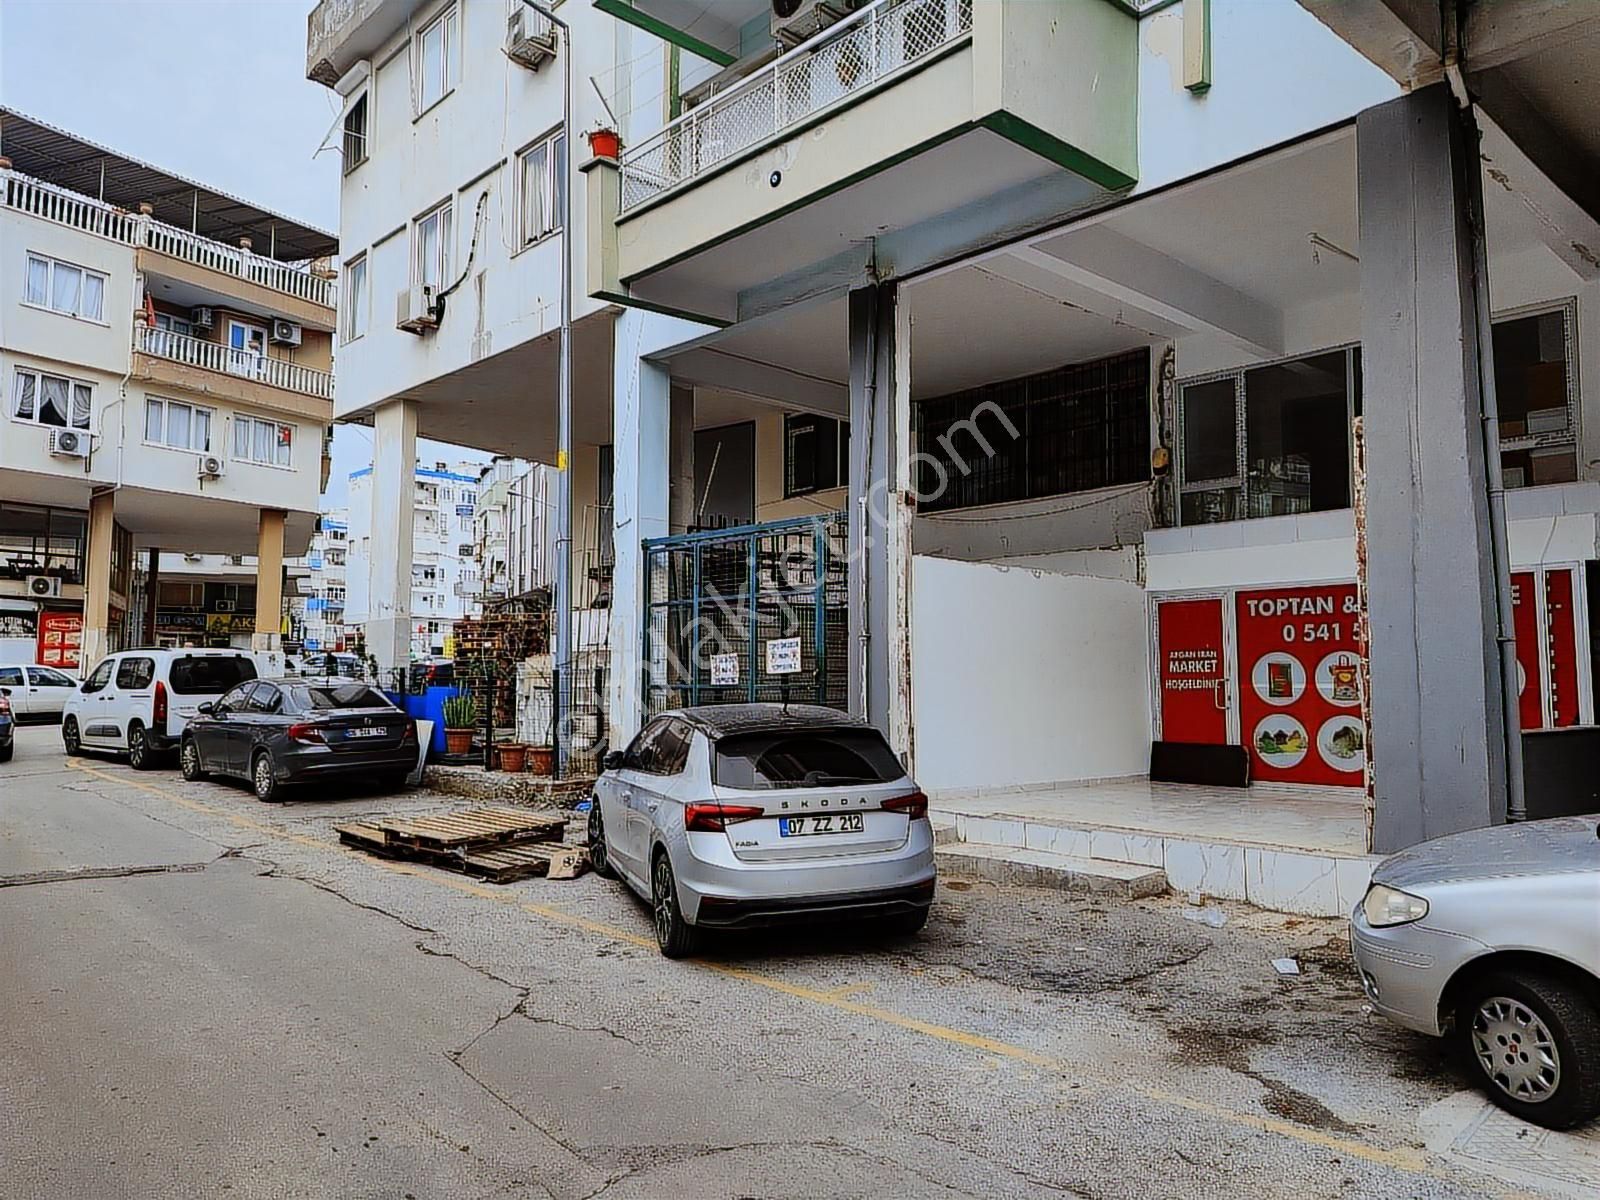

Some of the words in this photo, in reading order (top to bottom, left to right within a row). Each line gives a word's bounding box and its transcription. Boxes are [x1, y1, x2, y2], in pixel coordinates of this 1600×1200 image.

[1246, 596, 1334, 617] TOPTAN
[1282, 623, 1296, 643] 0
[1303, 622, 1341, 642] 541
[1169, 660, 1218, 674] MARKET
[780, 796, 868, 809] SKODA
[788, 818, 805, 834] 07
[812, 816, 833, 832] ZZ
[839, 815, 862, 831] 212
